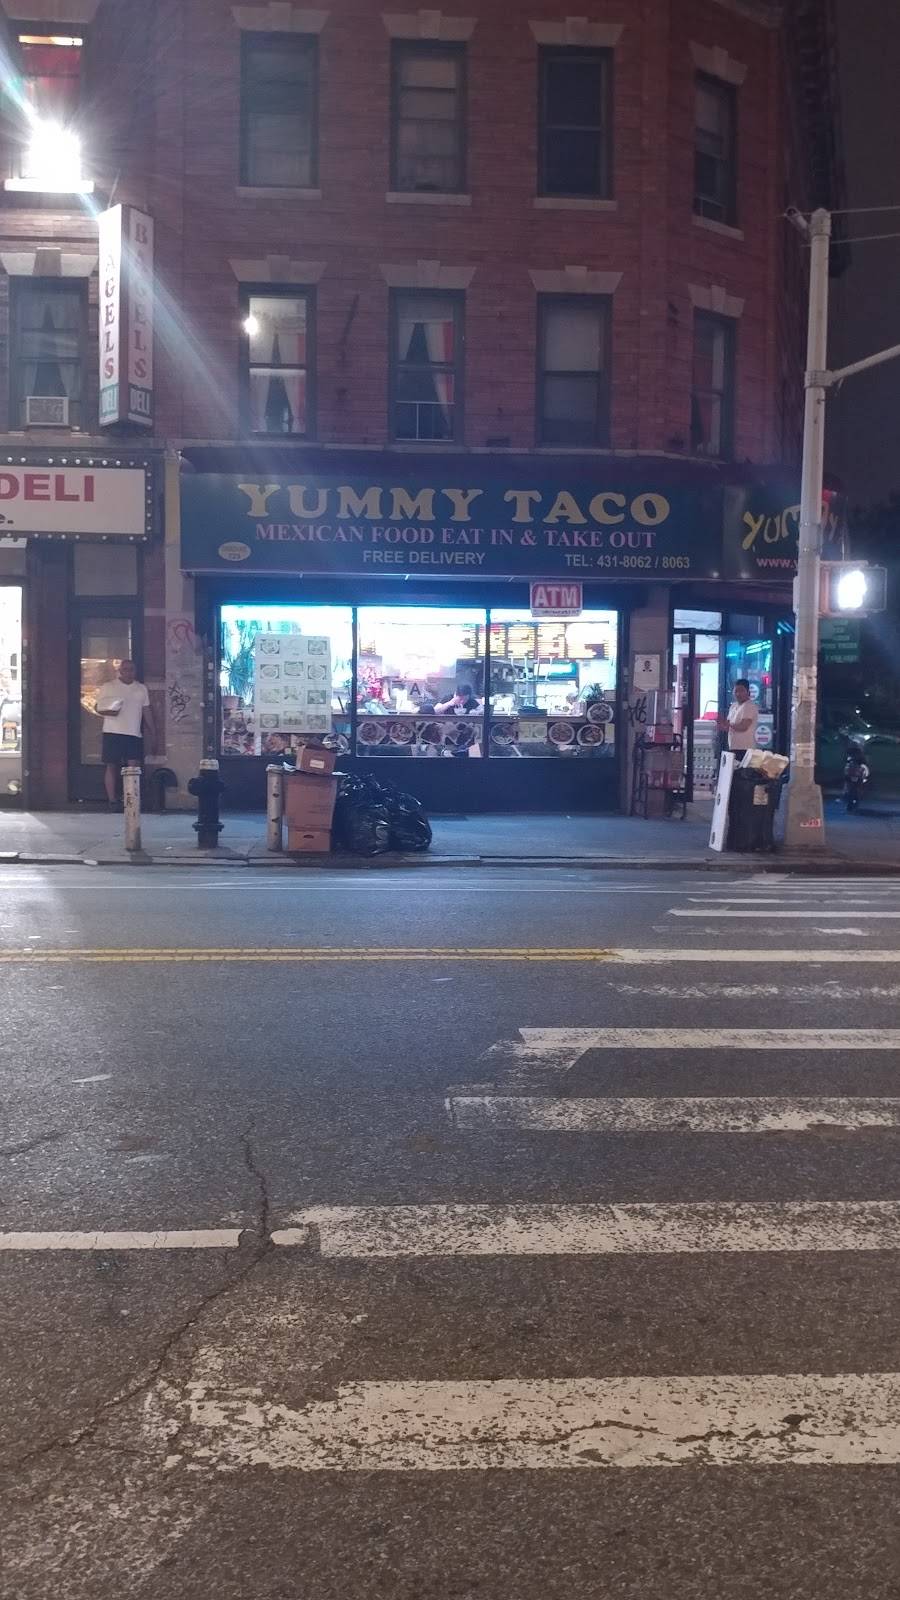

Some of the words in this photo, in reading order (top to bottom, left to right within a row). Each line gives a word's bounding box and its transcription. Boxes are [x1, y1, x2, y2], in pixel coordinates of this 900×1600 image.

[130, 389, 150, 415] DELI
[0, 473, 95, 502] DELI
[237, 483, 484, 522] YUMMY
[503, 490, 670, 526] TACO
[255, 523, 365, 543] MEXICAN
[371, 526, 435, 544] FOOD
[441, 528, 485, 545] EAT
[491, 529, 515, 545] IN
[519, 530, 537, 546] &
[543, 529, 601, 548] TAKE
[609, 531, 657, 549] OUT
[362, 550, 404, 564] FREE
[408, 551, 486, 565] DELIVERY
[564, 554, 593, 567] TEL:
[596, 554, 652, 569] 431-8062
[661, 555, 690, 569] 8063
[534, 584, 578, 608] ATM
[409, 682, 421, 695] A
